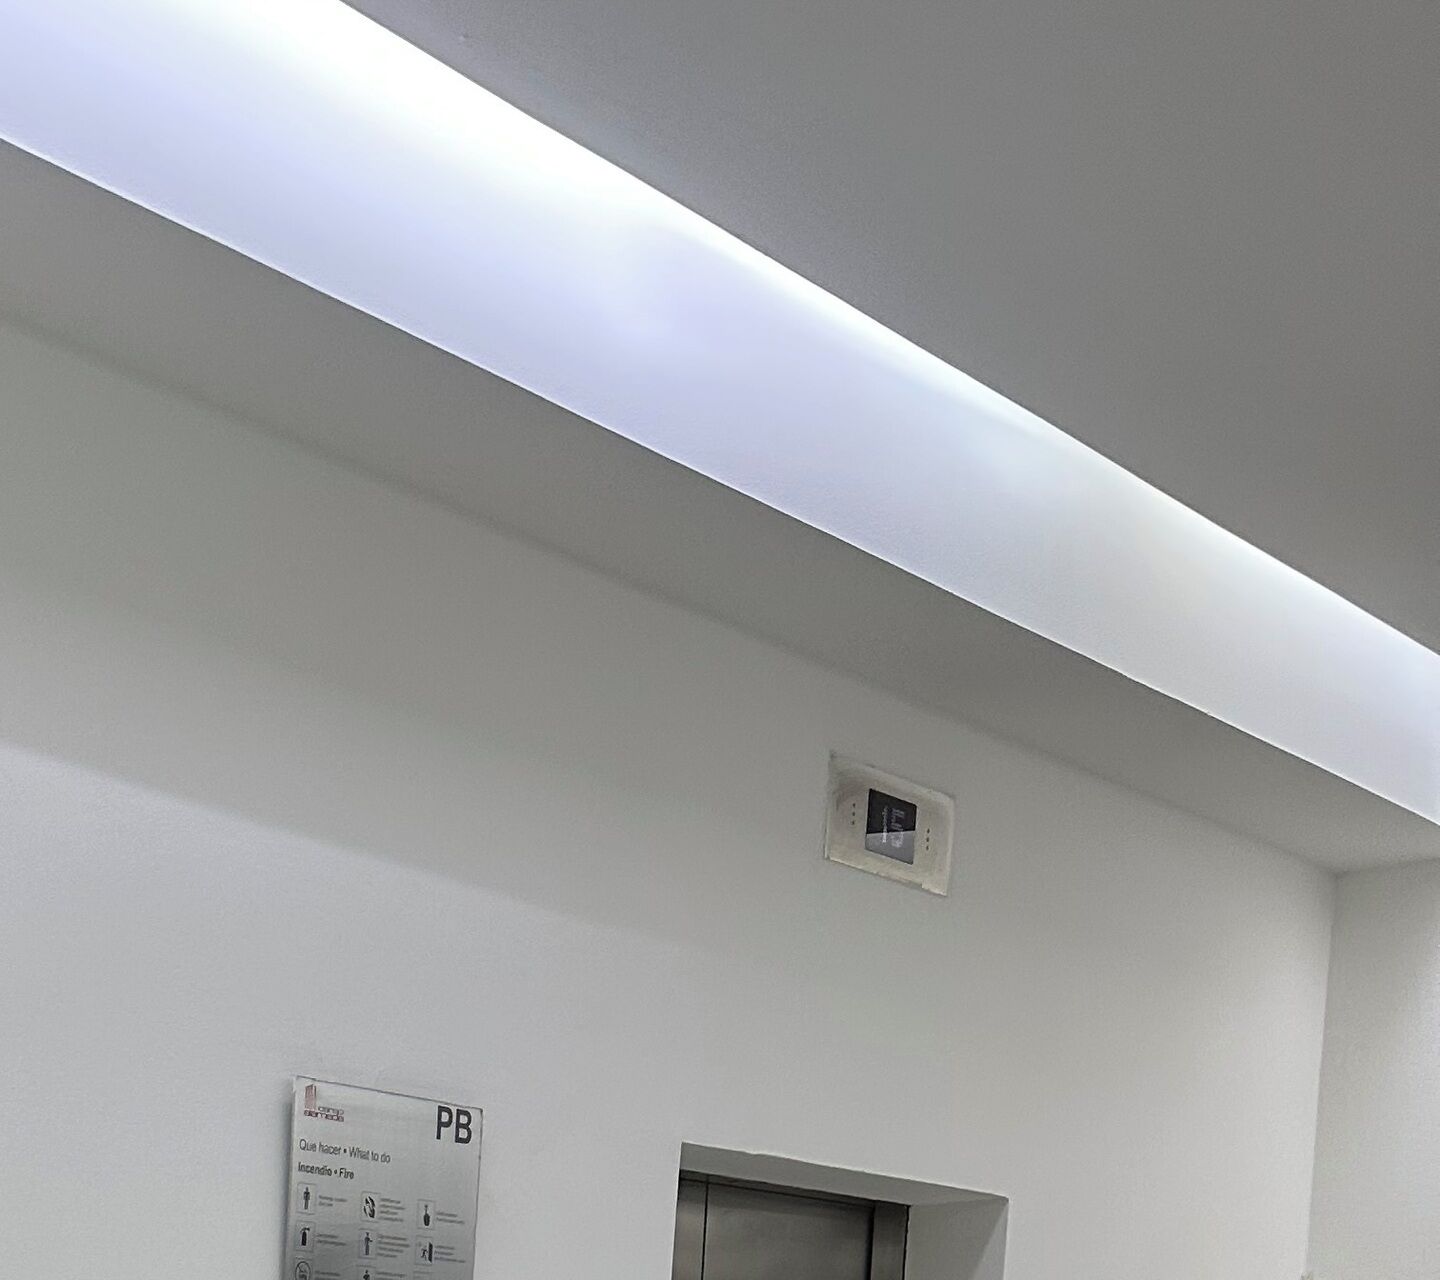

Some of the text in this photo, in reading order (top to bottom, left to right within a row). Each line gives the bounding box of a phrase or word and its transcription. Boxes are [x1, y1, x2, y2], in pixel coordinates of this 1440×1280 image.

[436, 1104, 472, 1144] PB
[299, 1138, 391, 1164] Que hacer What to do
[339, 1167, 355, 1180] Fire
